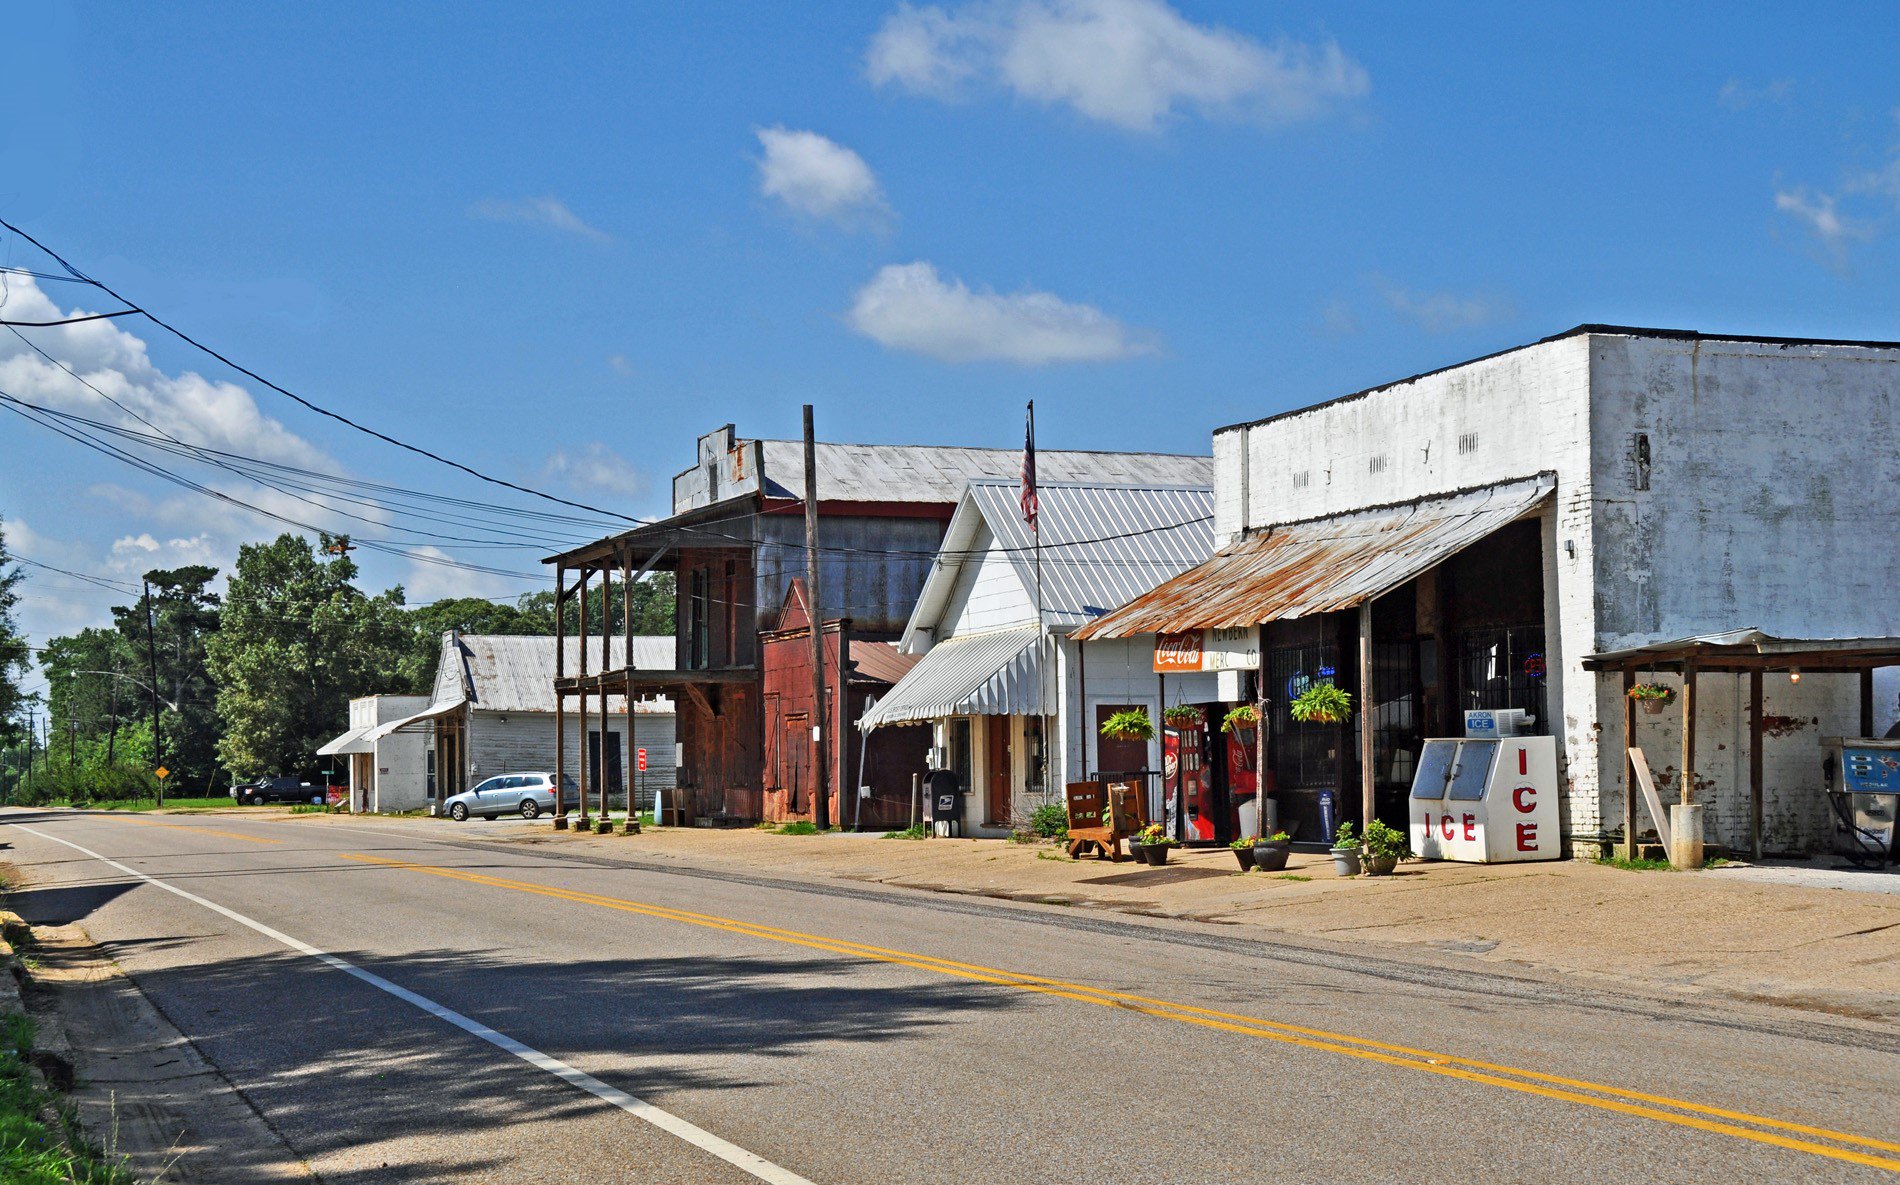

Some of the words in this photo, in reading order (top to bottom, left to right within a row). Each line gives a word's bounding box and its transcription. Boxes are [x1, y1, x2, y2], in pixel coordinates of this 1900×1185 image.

[1213, 626, 1248, 642] NEWBERN
[1210, 651, 1229, 668] MERC
[1246, 649, 1257, 666] CO
[1468, 711, 1492, 719] AKRON
[1472, 719, 1489, 728] ICE
[1512, 745, 1539, 852] ICE
[1424, 812, 1476, 841] ICE
